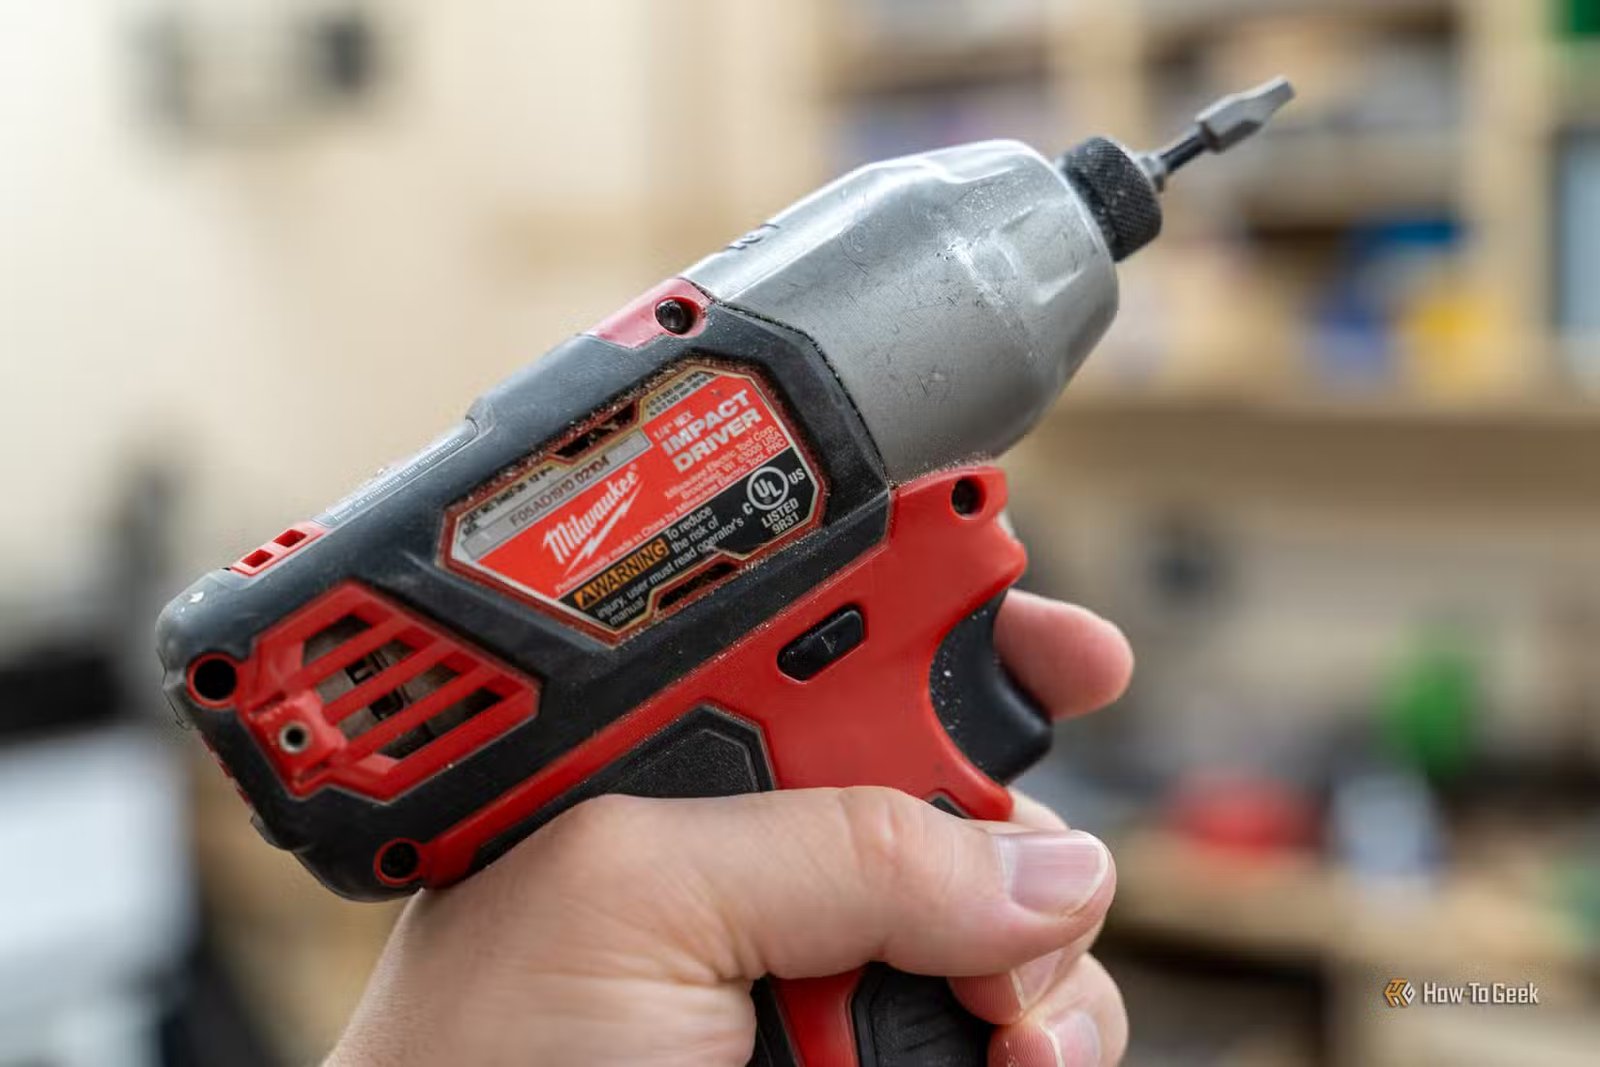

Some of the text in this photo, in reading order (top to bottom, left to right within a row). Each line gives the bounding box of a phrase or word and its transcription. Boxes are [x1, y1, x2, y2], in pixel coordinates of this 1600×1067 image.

[661, 388, 752, 455] IMPACT
[673, 409, 694, 428] HEX
[672, 406, 762, 472] DRIVER
[705, 447, 737, 472] Electric
[735, 436, 754, 452] Tool
[752, 423, 777, 442] Corp.
[761, 430, 782, 447] USA
[717, 463, 748, 487] Electric
[765, 437, 787, 455] PRC
[754, 478, 782, 499] UL
[787, 467, 806, 485] US
[541, 469, 638, 563] Milwaukee
[663, 502, 713, 541] To reduce
[760, 496, 800, 528] LISTED
[771, 510, 800, 534] 9R31
[670, 515, 720, 553] the risk of
[589, 538, 669, 598] WARNING
[625, 579, 649, 600] user
[647, 561, 675, 585] must
[672, 546, 697, 568] read
[694, 514, 745, 555] operator's
[608, 595, 646, 625] manual
